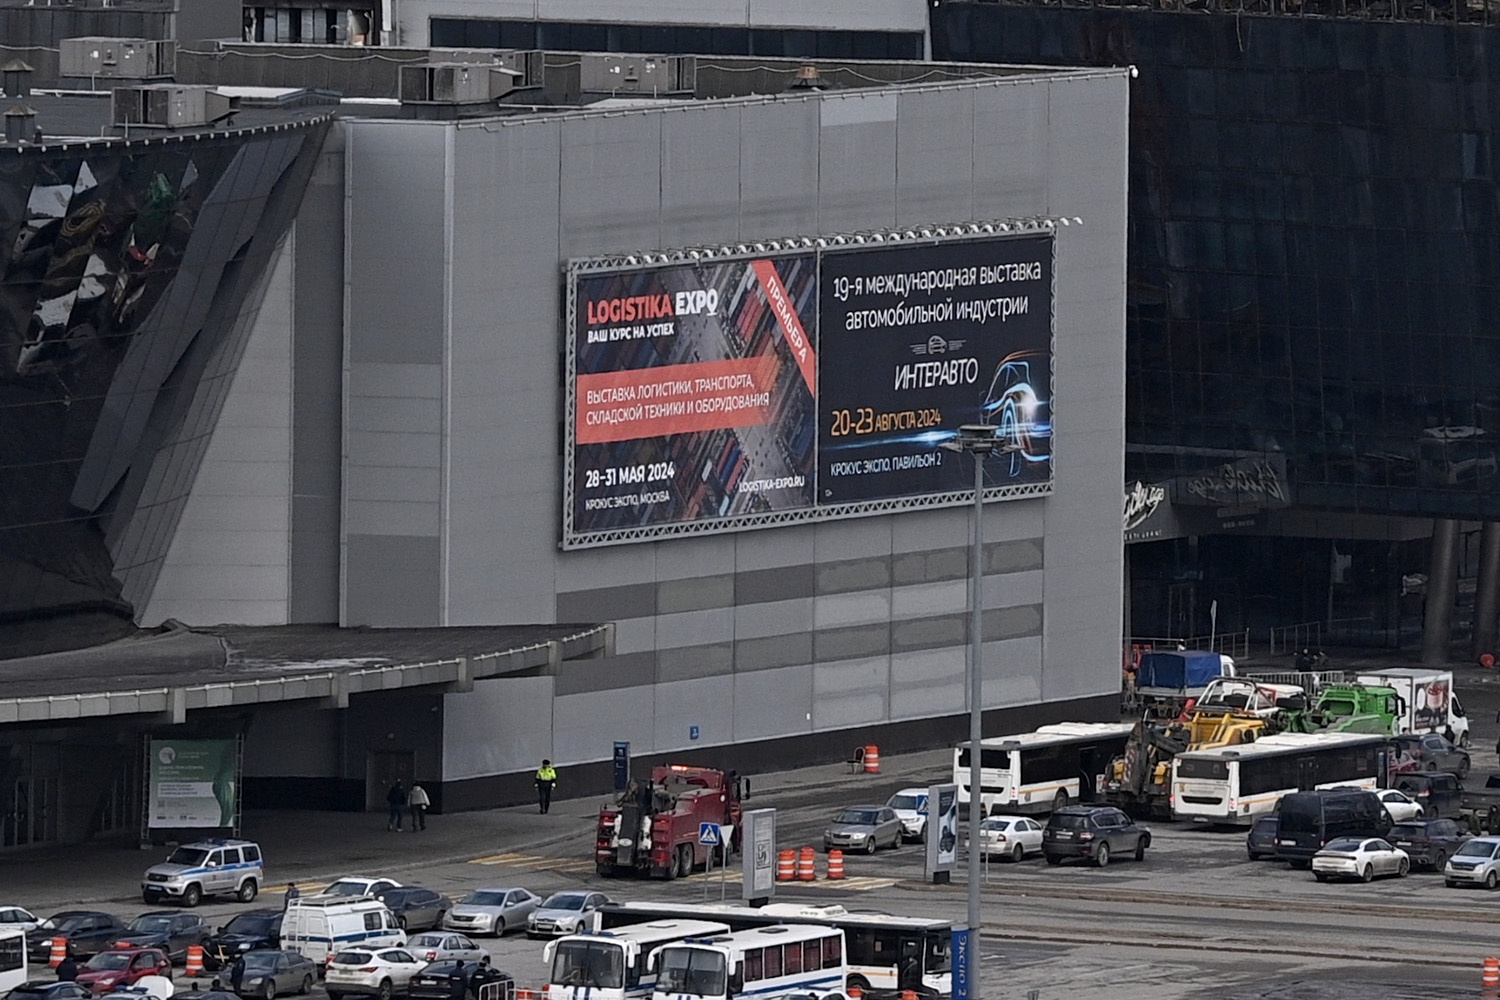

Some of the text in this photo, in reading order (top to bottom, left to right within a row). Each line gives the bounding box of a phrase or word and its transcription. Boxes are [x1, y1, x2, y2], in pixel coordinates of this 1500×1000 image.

[833, 261, 1041, 301] 19-я международная выставка
[588, 288, 718, 324] LOGISTIKA EXPO
[766, 276, 807, 363] ПРЕМЬЕРА
[846, 296, 1028, 330] автомобильной индустрии
[588, 322, 675, 344] ВАШ КУРС НА УСПЕХ
[587, 374, 755, 405] ВЫСТАВКА ЛОГИСТИКИ, ТРАНСПОРТА,
[895, 357, 979, 391] ИНТЕРАВТО
[586, 393, 769, 426] СКЛАДСКОЙ ТЕХНИКИ И ОБОРУДОВАНИЯ
[831, 408, 942, 436] 20-23 АВГУСТА 2024
[619, 466, 645, 485] МАЯ
[647, 462, 675, 482] 2024
[831, 461, 862, 477] КРОКУС
[892, 455, 935, 471] ПАВИЛЬОН
[936, 453, 942, 466] 2
[739, 476, 805, 493] LOGISTIKA-EXPO.RU
[958, 935, 967, 984] Экспо
